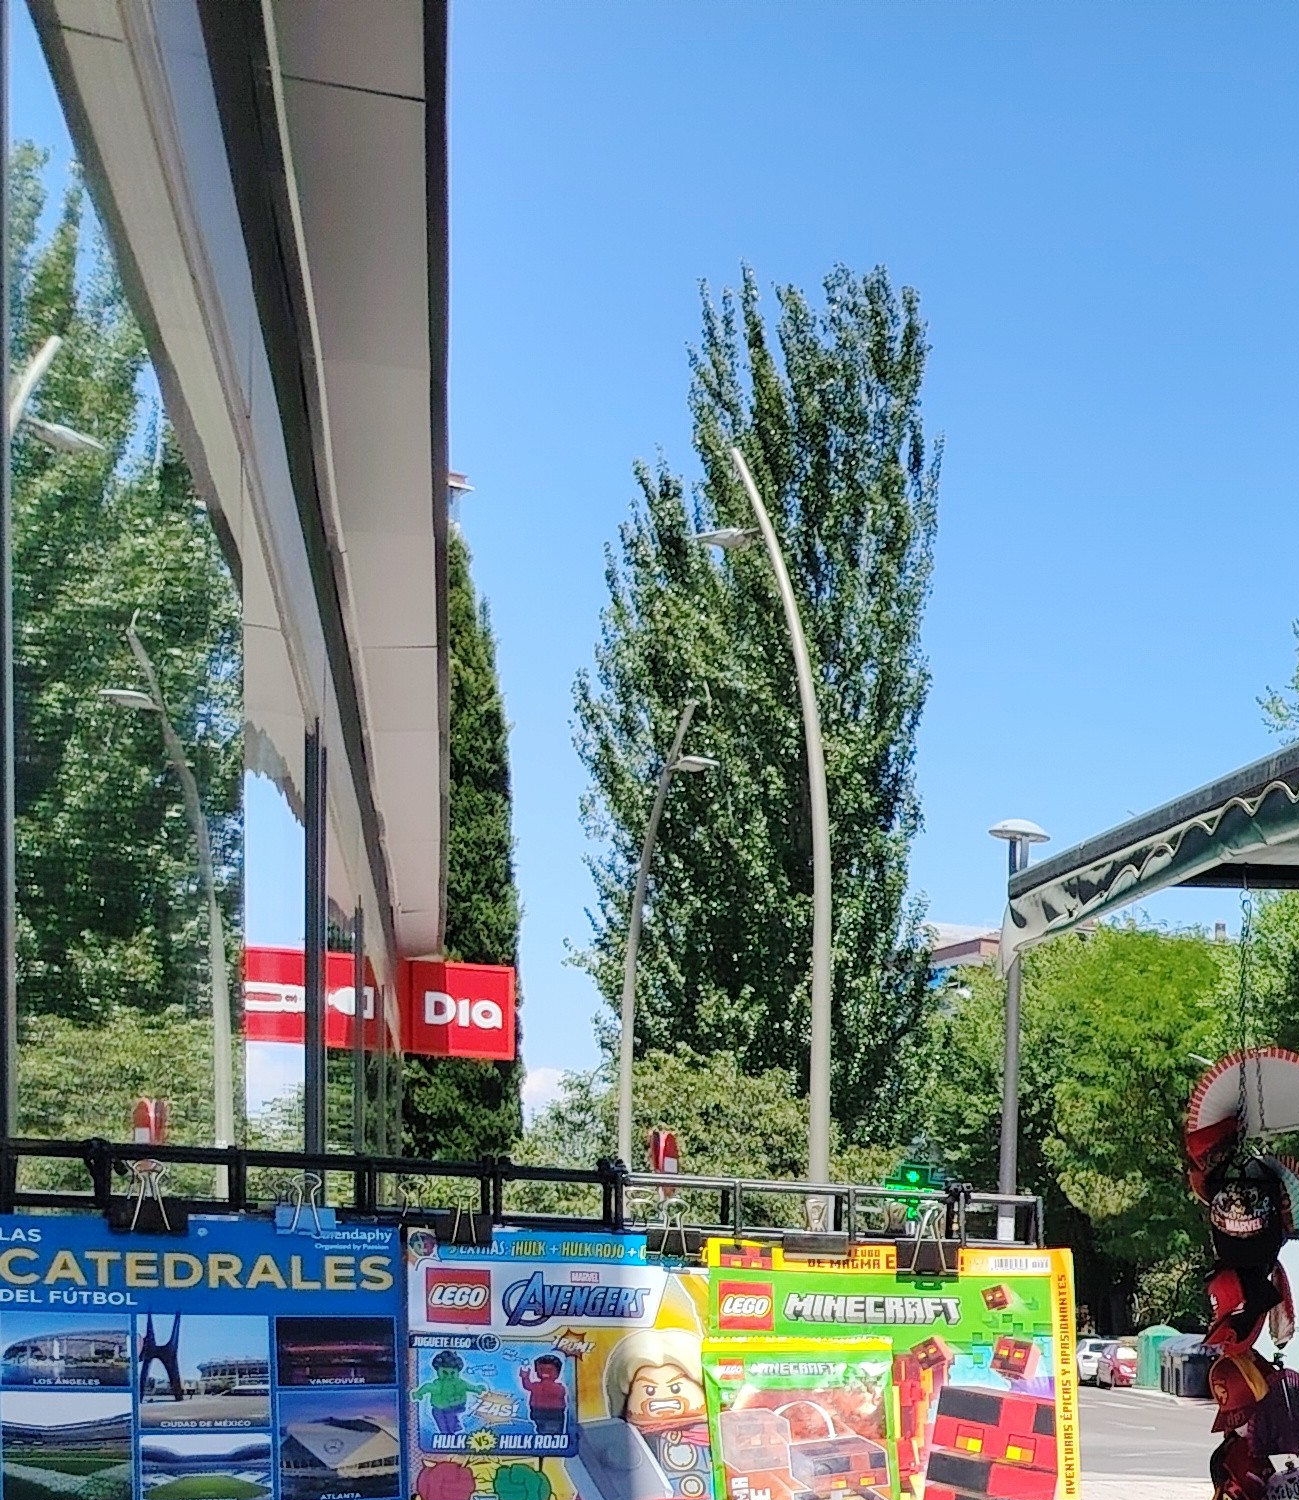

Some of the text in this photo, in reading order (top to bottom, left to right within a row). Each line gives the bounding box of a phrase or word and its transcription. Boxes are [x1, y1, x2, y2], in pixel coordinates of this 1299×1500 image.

[0, 1228, 42, 1243] LAS
[0, 1247, 395, 1292] CATEDRALES
[0, 1286, 138, 1307] DEL FÚTBOL
[428, 1283, 489, 1308] LEGO
[502, 1271, 651, 1326] AVENGERS
[721, 1294, 771, 1316] LEGO
[784, 1292, 963, 1325] MINECRAFT
[309, 1377, 366, 1385] VANCOUVER
[160, 1418, 251, 1428] CIUDAD DE MÉXICO
